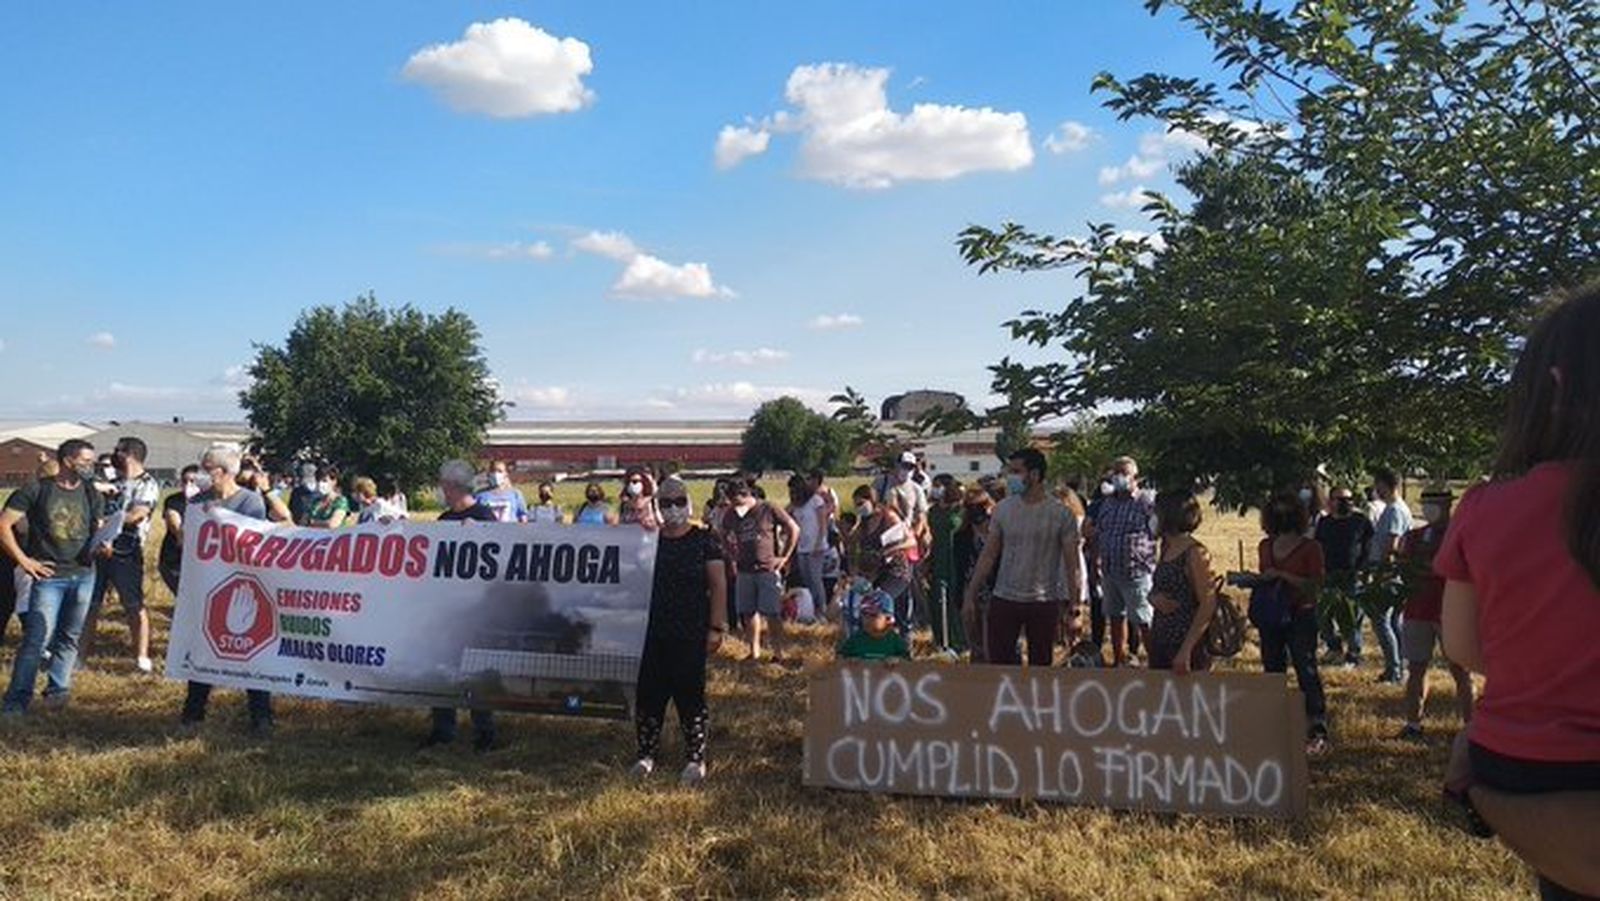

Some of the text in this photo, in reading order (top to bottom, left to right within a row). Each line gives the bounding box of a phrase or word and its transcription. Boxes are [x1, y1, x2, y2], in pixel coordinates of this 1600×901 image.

[196, 519, 620, 584] CORRUGADOS NOS AHOGA
[277, 588, 362, 613] EMISIONES
[218, 633, 254, 651] STOP
[278, 637, 387, 667] MALOS OLORES
[840, 667, 1229, 745] NOS AHOGAN
[1035, 746, 1083, 798] LO
